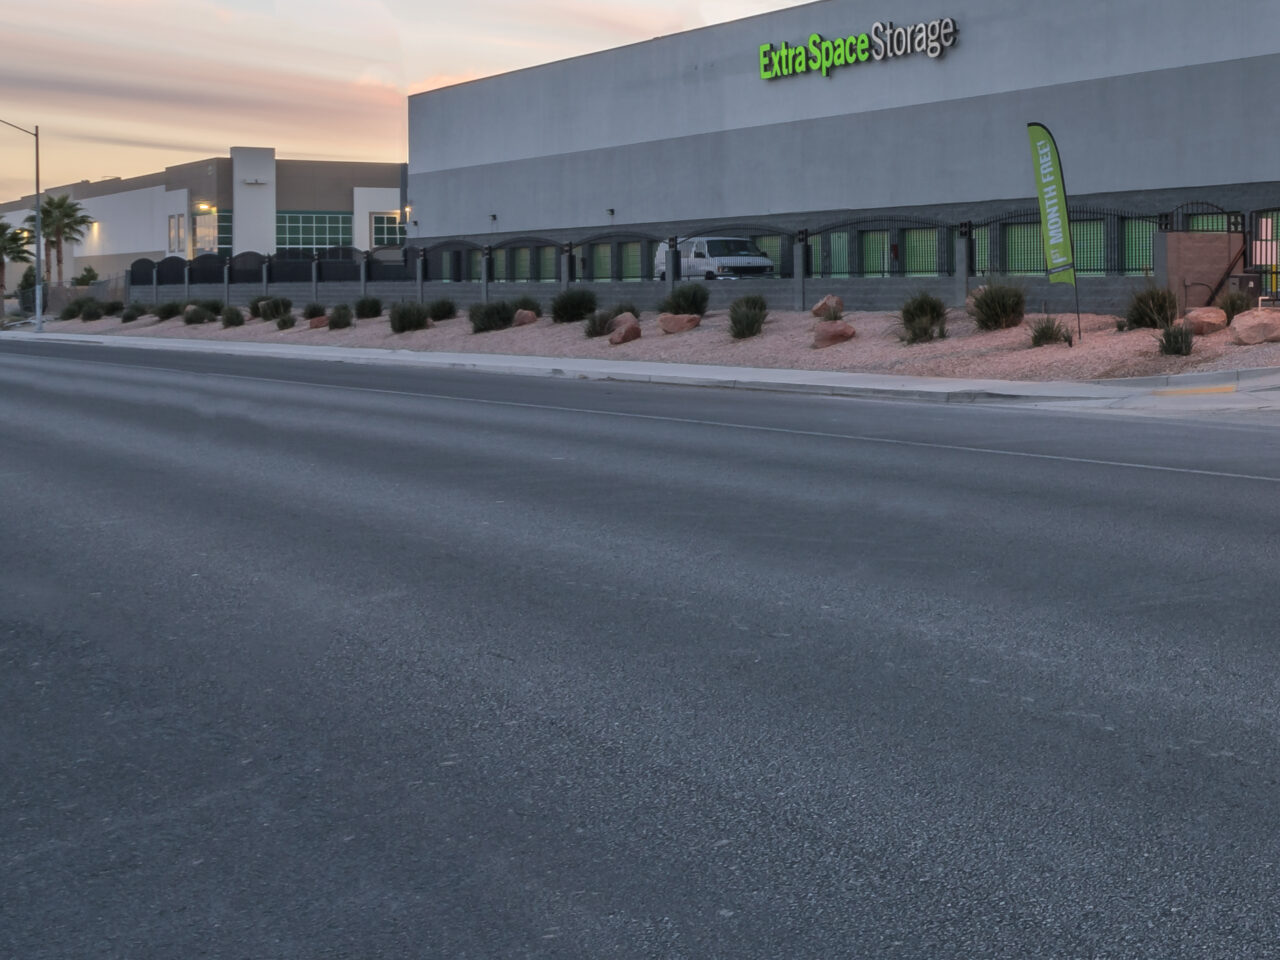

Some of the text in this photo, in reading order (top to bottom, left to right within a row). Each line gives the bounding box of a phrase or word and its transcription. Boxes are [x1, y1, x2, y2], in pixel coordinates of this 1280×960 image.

[759, 17, 955, 80] Extra Space Storage
[1036, 139, 1055, 184] FREE!
[1043, 184, 1064, 246] MONTH
